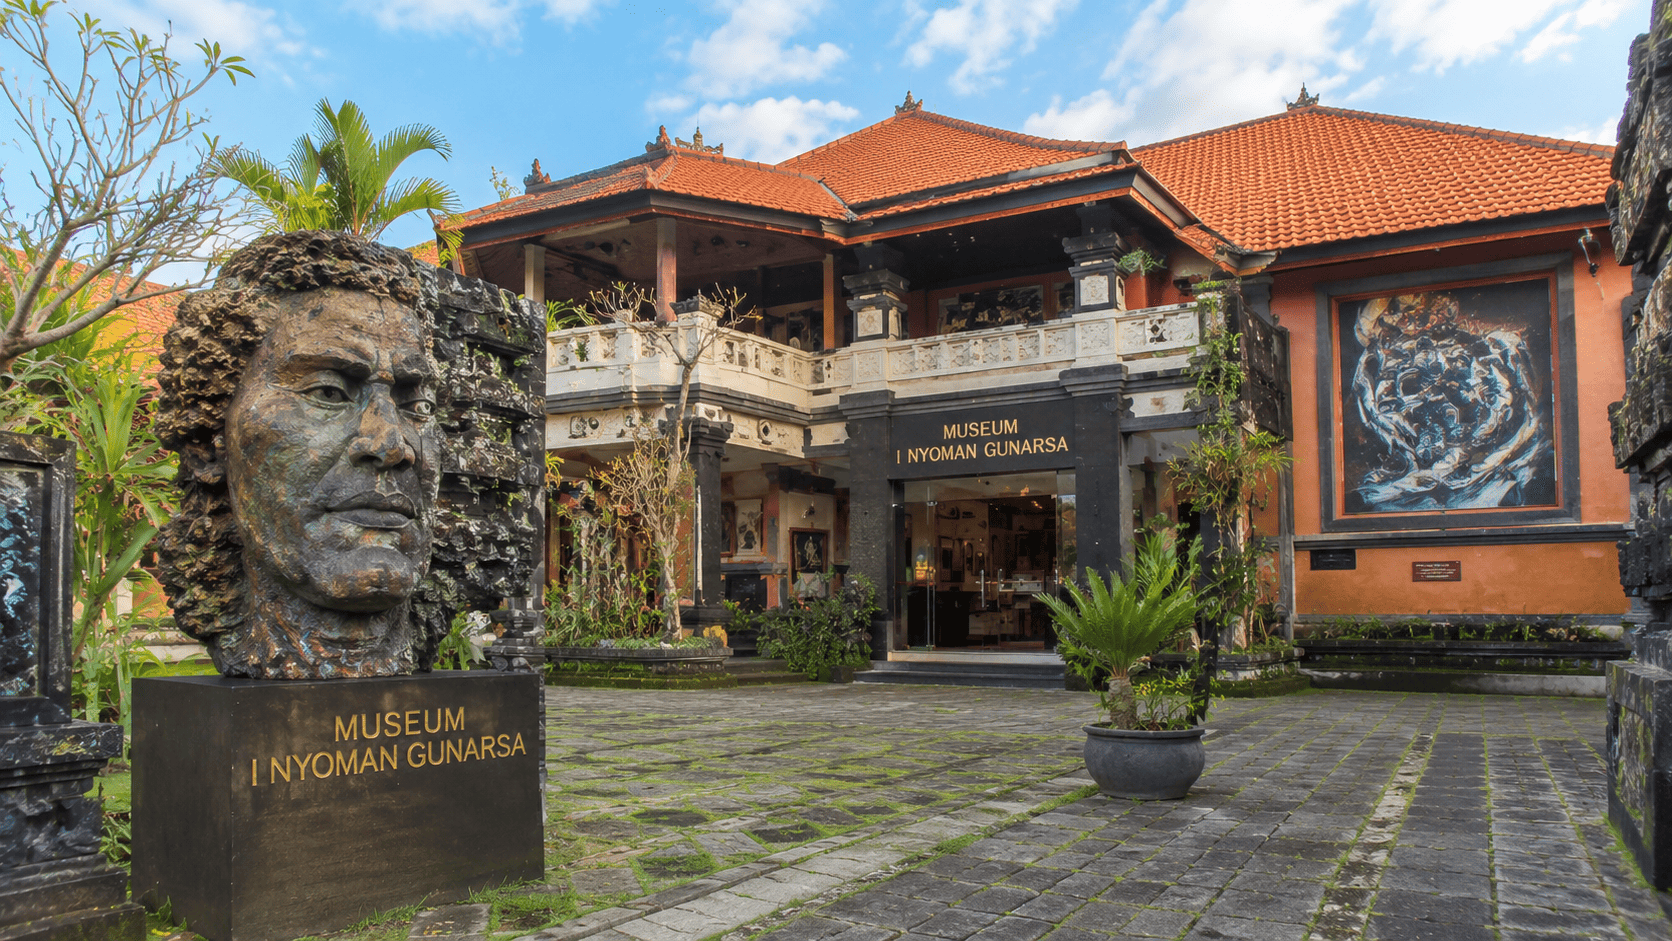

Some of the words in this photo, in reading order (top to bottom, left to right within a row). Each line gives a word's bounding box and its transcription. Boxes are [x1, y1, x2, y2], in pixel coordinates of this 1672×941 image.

[943, 419, 1018, 439] MUSEUM
[896, 450, 901, 464] I
[908, 443, 977, 464] NYOMAN
[984, 436, 1069, 458] GUNARSA
[335, 706, 465, 742] MUSEUM
[252, 758, 257, 786] I
[270, 744, 398, 784] NYOMAN
[407, 732, 527, 768] GUNARSA
